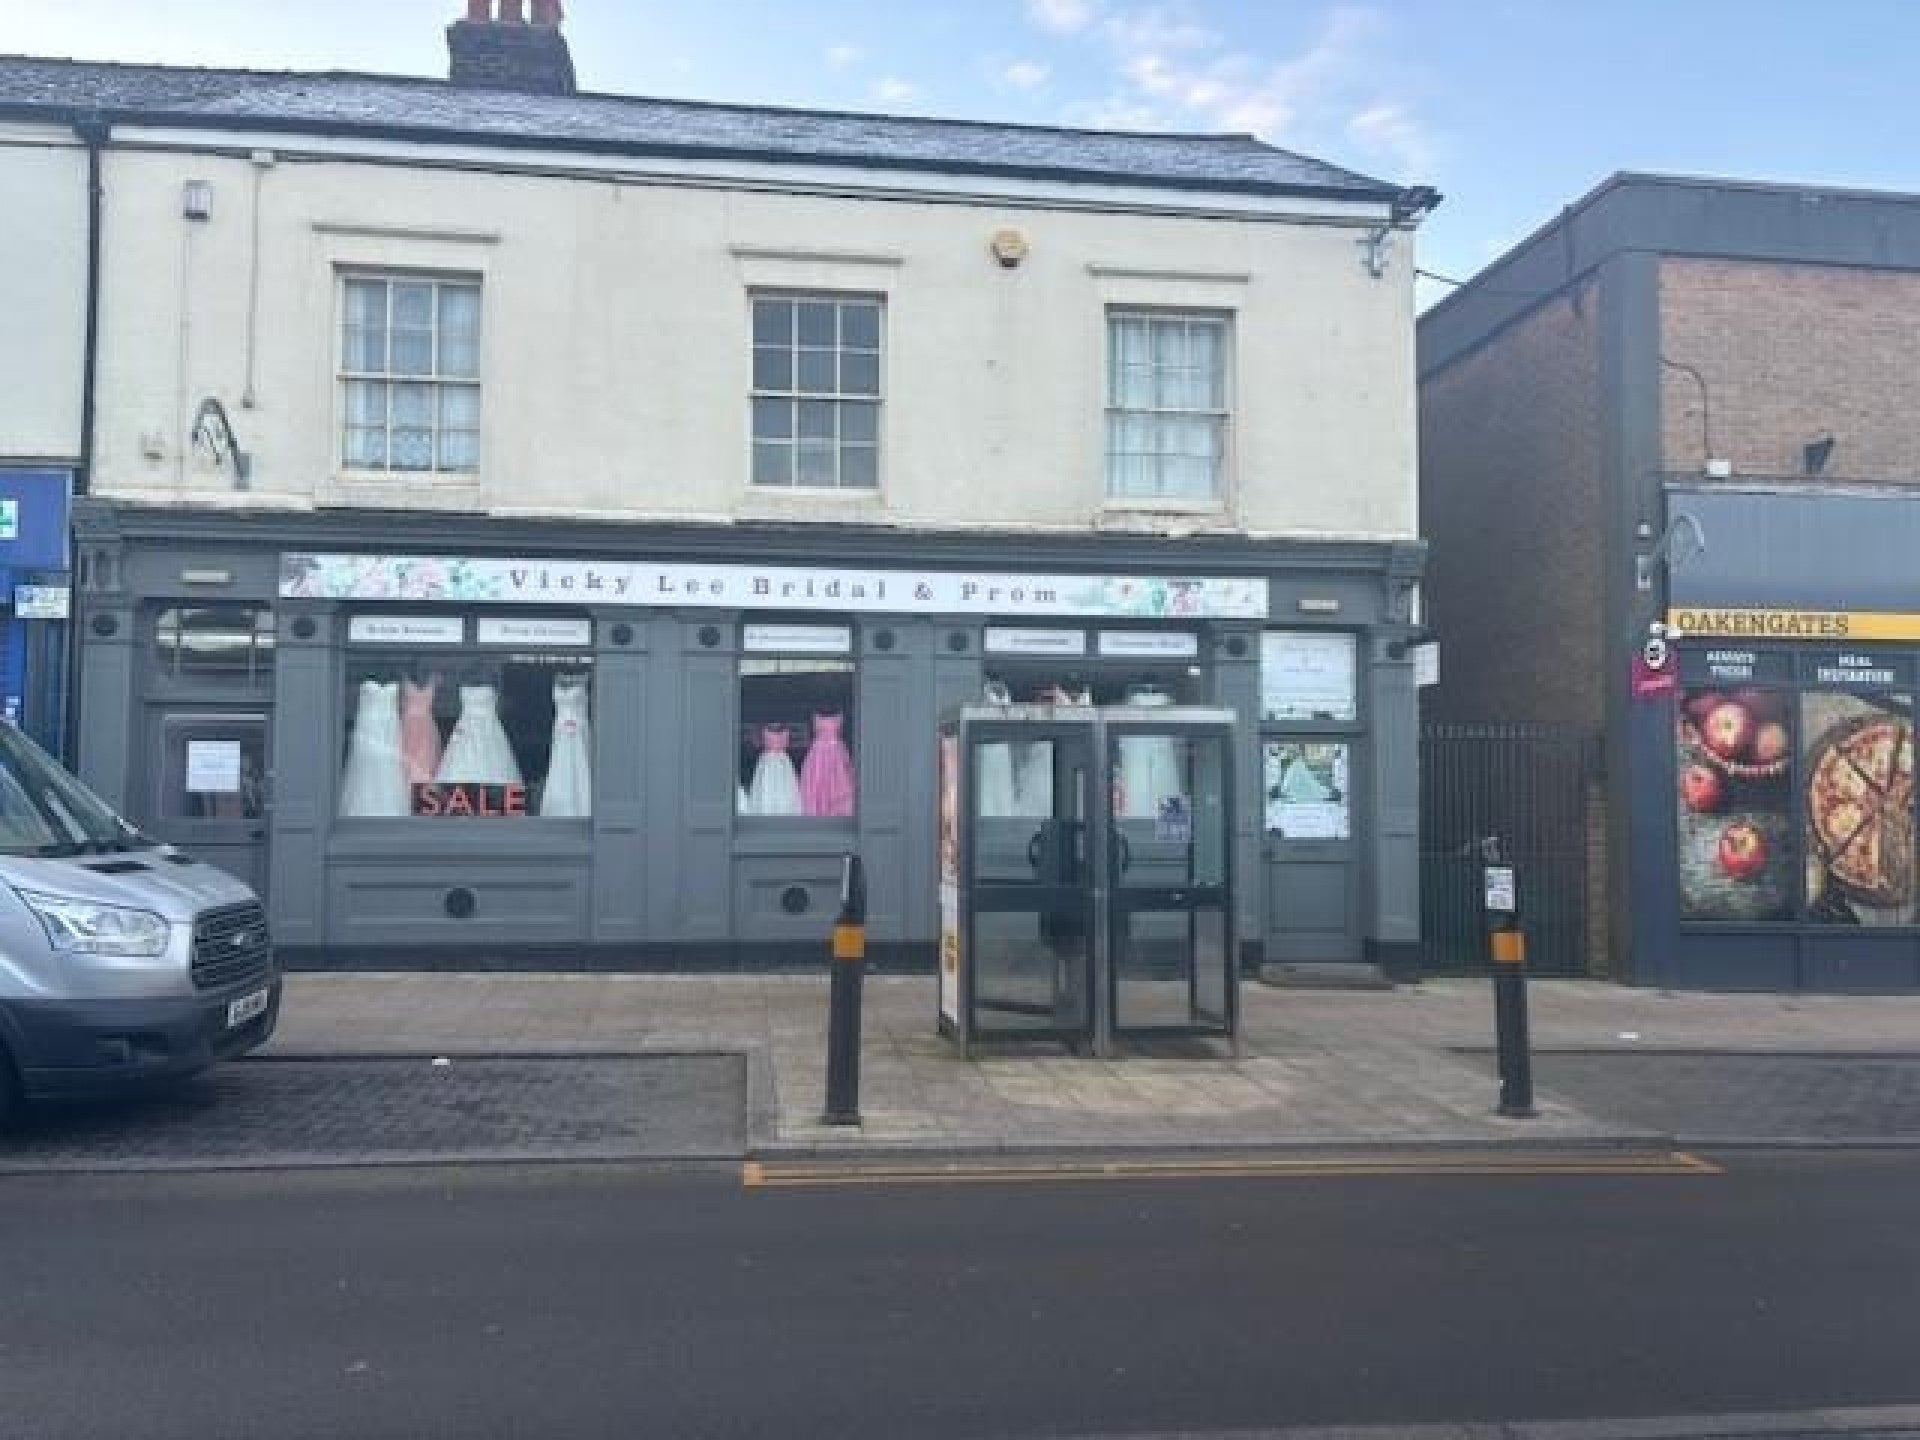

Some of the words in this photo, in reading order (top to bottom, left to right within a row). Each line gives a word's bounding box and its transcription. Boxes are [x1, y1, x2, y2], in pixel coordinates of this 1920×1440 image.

[510, 570, 630, 594] Vicky
[659, 575, 724, 595] Lee
[753, 576, 887, 600] Bridal
[914, 581, 934, 601] &
[962, 582, 1056, 602] Prom
[1679, 612, 1848, 635] OAKENGATES
[420, 782, 526, 816] SALE
